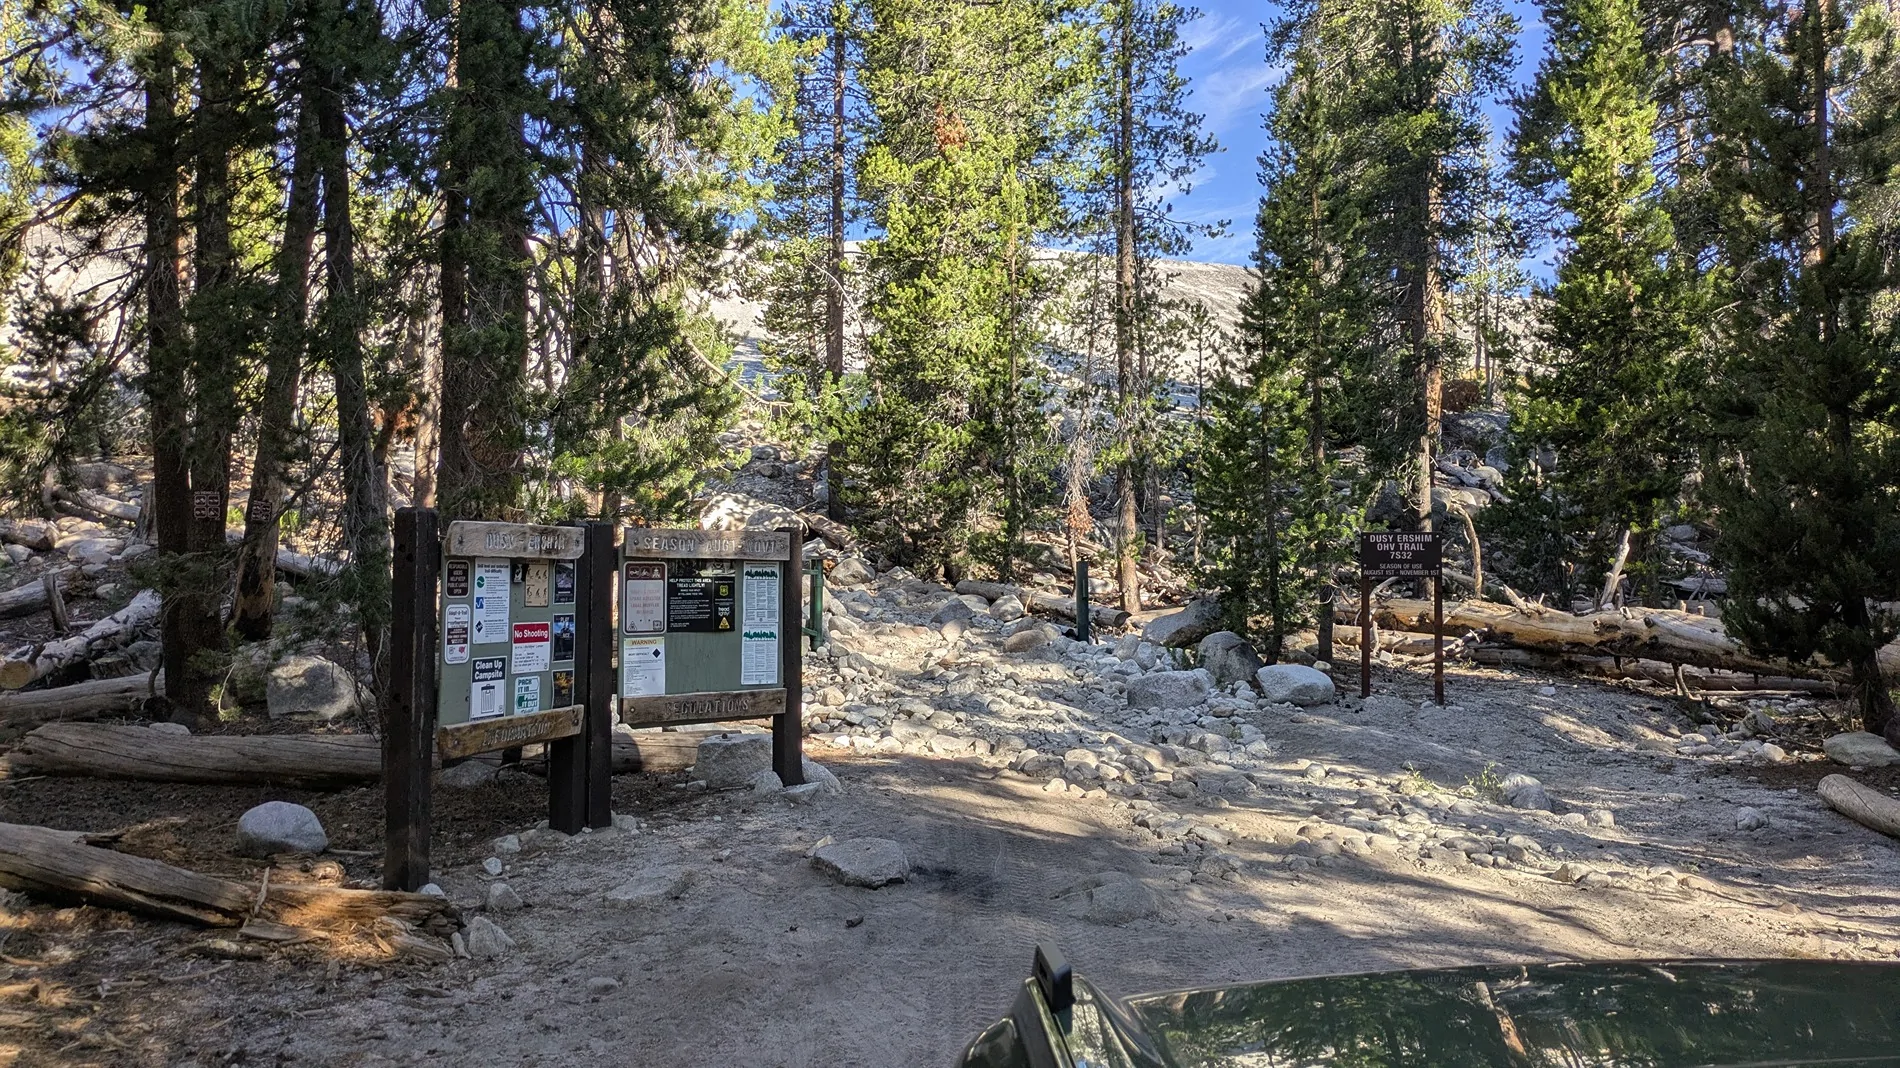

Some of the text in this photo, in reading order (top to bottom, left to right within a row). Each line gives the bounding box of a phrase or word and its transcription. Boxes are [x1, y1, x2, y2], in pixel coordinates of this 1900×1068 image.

[486, 532, 514, 550] DUSY
[528, 533, 565, 550] ERSHIM
[1370, 534, 1432, 542] DUSY ERSHIM
[644, 537, 696, 551] SEASON
[1377, 543, 1425, 551] OHV TRAIL
[1390, 552, 1412, 560] 7S32
[524, 629, 548, 638] Shooting
[476, 660, 502, 670] Clean Up
[475, 670, 502, 680] Campsite
[664, 698, 749, 716] REGULATIONS
